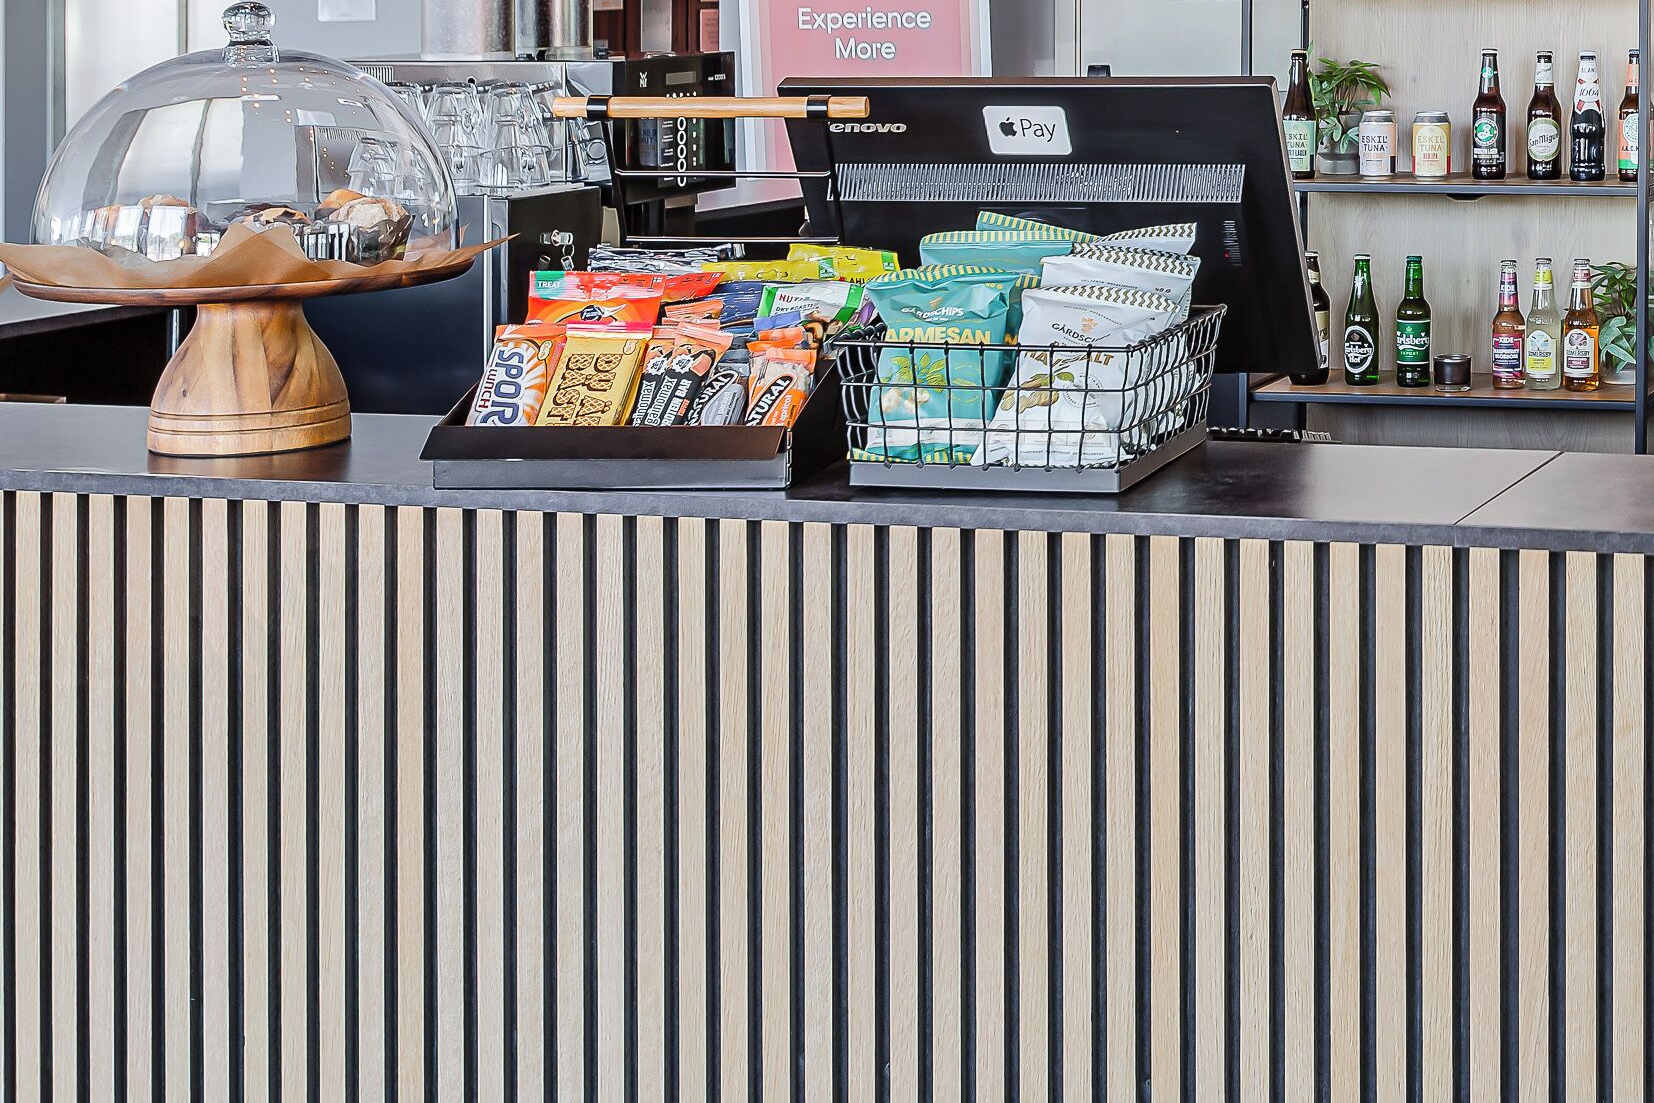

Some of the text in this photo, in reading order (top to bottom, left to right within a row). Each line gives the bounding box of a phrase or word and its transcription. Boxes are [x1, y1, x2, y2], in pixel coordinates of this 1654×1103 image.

[797, 6, 932, 33] Experience
[834, 37, 897, 60] More
[829, 122, 908, 133] enovo
[1019, 117, 1056, 143] Pay
[537, 280, 561, 289] TREAT
[884, 326, 991, 345] ARMESAN
[1051, 323, 1097, 344] GÅRDSC
[1396, 331, 1430, 346] arlsberg
[477, 369, 498, 409] LUNCH
[679, 378, 693, 399] BAR
[645, 375, 678, 426] gainomax
[746, 378, 791, 426] ATURAL
